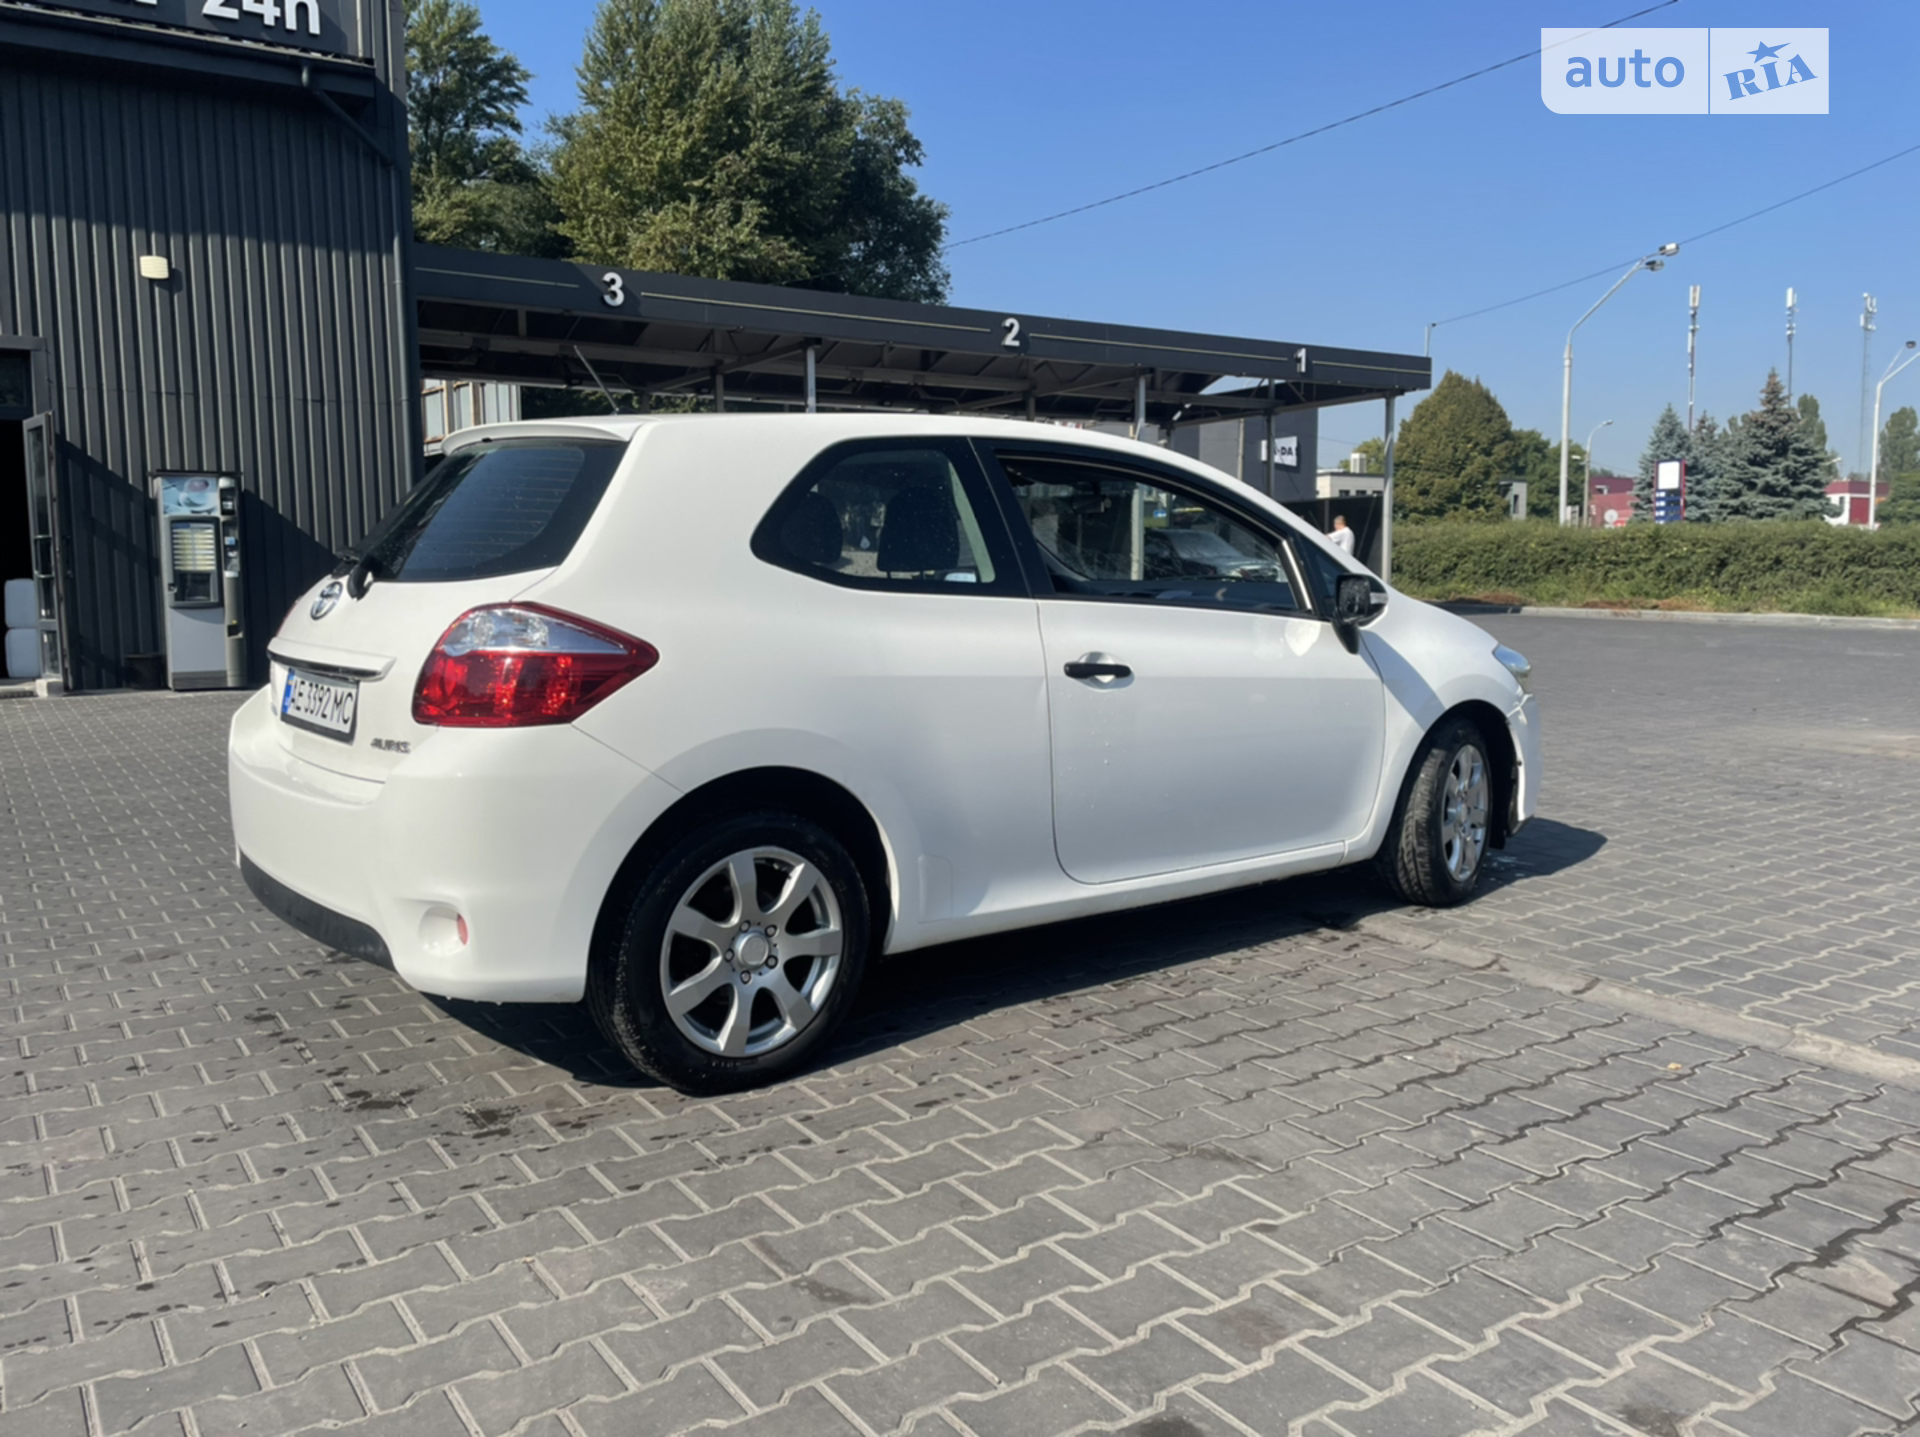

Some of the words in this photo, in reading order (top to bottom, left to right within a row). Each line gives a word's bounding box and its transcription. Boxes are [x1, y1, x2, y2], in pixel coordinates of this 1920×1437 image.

[602, 271, 625, 307] 3
[1001, 317, 1020, 347] 2
[1294, 347, 1306, 373] 1
[329, 688, 354, 725] MC
